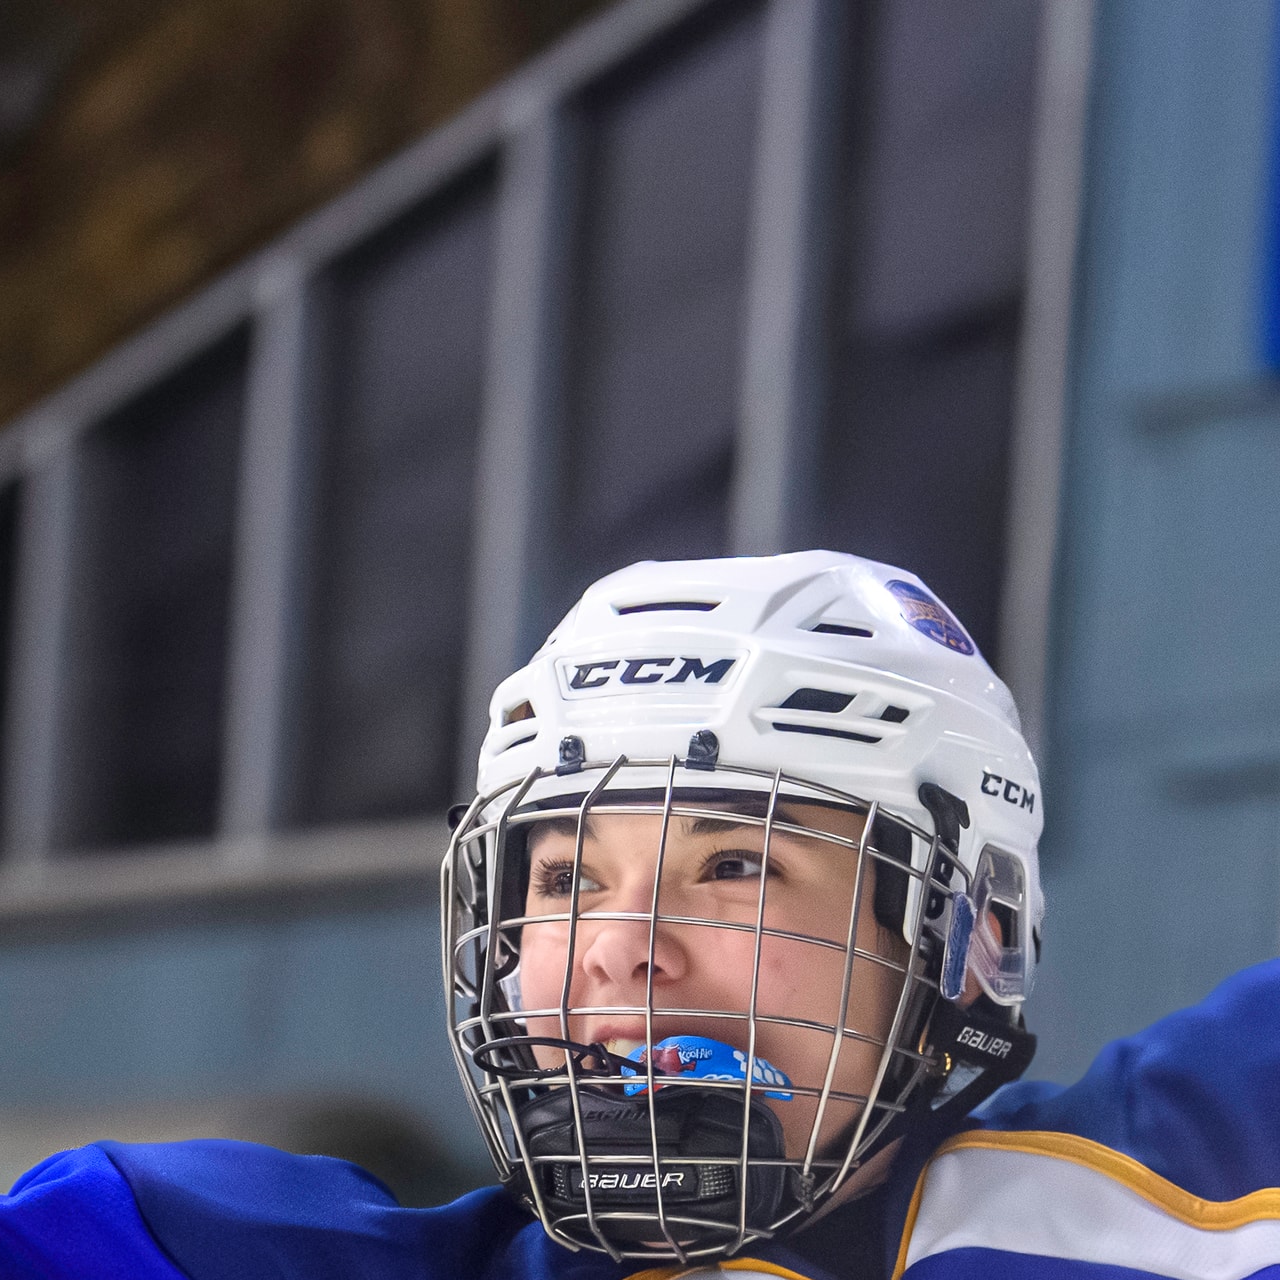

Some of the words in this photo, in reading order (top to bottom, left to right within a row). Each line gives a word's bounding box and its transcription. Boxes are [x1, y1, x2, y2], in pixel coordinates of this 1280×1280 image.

[569, 656, 737, 690] CCM
[981, 769, 1035, 814] CCM
[956, 1025, 1013, 1060] BAUER
[579, 1171, 685, 1190] BAUER
